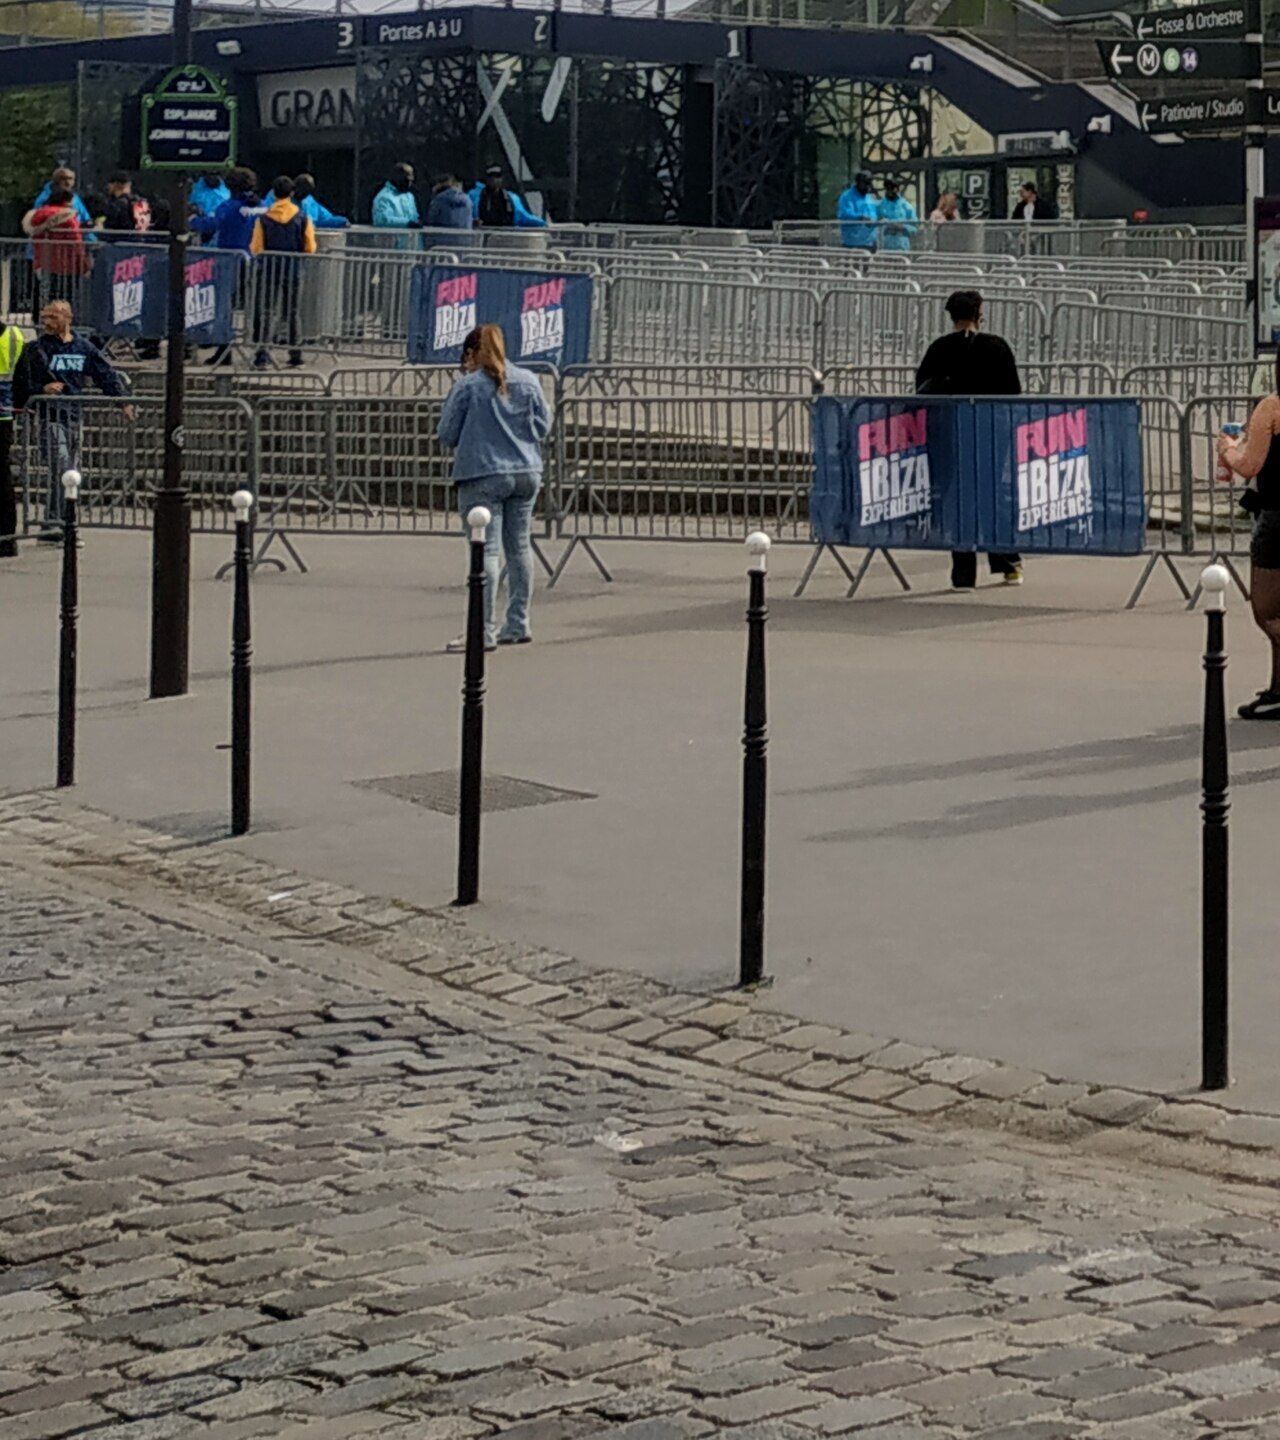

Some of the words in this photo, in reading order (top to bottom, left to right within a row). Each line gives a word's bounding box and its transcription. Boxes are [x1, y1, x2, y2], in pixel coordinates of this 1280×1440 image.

[337, 22, 353, 47] 3
[379, 23, 423, 42] Portes
[425, 21, 436, 38] A
[438, 19, 449, 37] à
[450, 18, 462, 36] U
[534, 15, 547, 42] 2
[1155, 18, 1185, 35] Fosse
[1185, 13, 1195, 30] &
[1196, 10, 1243, 30] Orchestre
[727, 30, 740, 57] 1
[1161, 103, 1203, 122] Patinoire
[1212, 98, 1244, 117] Studio
[969, 174, 982, 194] P
[436, 273, 477, 307] FUN
[522, 278, 566, 311] FUN
[49, 354, 86, 371] VANS
[858, 409, 927, 462] FUN
[1017, 408, 1088, 463] FUN
[860, 490, 931, 527] EXPERIENCE
[1018, 490, 1093, 531] EXPERIENCE
